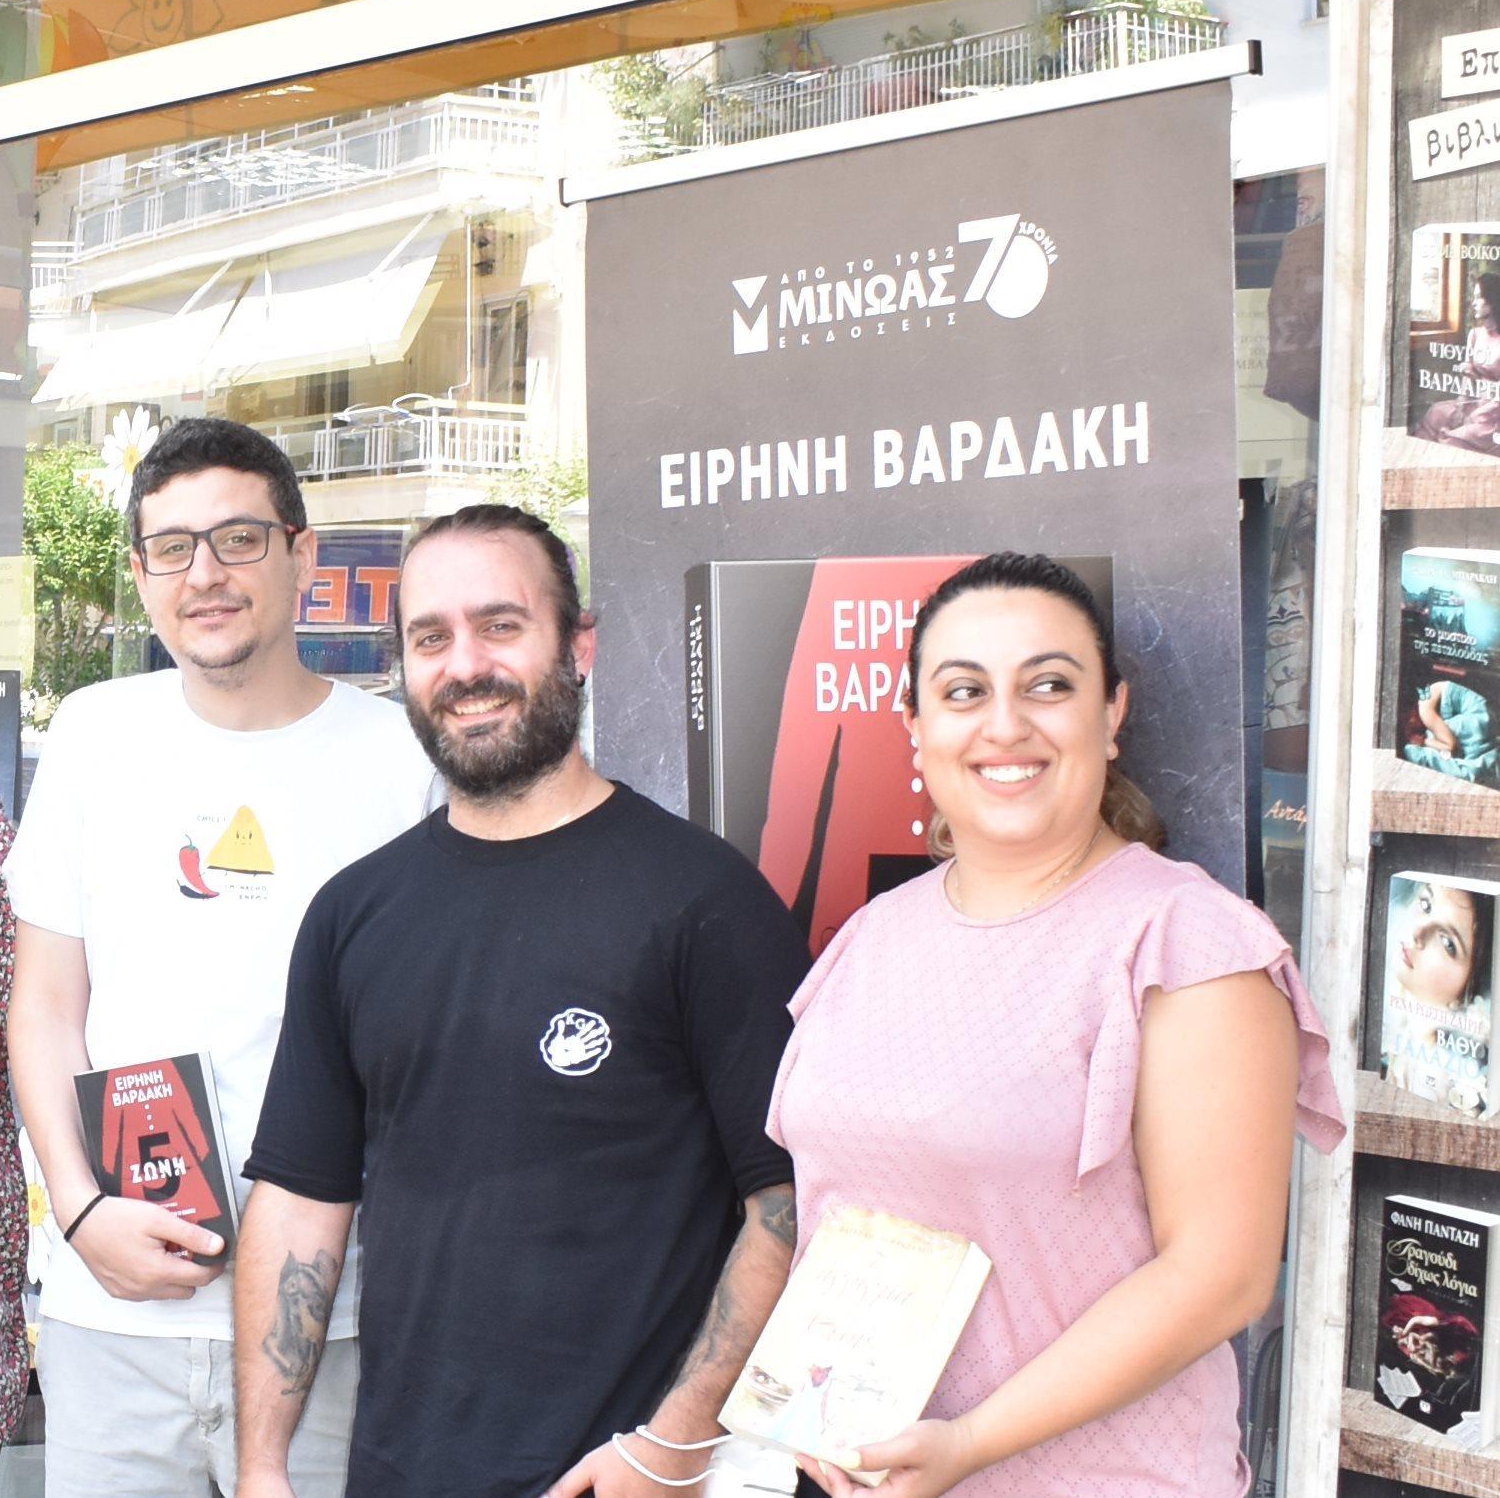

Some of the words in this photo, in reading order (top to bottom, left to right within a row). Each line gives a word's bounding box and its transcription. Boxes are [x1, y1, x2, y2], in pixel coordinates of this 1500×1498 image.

[1018, 220, 1059, 267] ΧΡΟΝΙΑ
[780, 265, 826, 285] ΑΠΟ
[846, 258, 874, 274] ΤΟ
[895, 245, 955, 266] 1952
[778, 263, 956, 329] ΜΙΝΩΑΣ
[778, 312, 956, 350] ΕΚΔΟΣΕΙΣ
[659, 434, 847, 509] ΕΙΡΗΝΗ
[872, 401, 1150, 489] ΒΑΡΔΑΚΗ
[1436, 1029, 1481, 1058] ΒΑΘΥ
[111, 1083, 173, 1107] ΒΑΡΔΑΚΗ
[114, 1069, 165, 1092] ΕΙΡΗΝΗ
[129, 1155, 187, 1184] ΖΩΝΗ
[1390, 1211, 1422, 1232] ΦΑΝΗ
[1424, 1219, 1480, 1248] ΠΑΝΤΑΖΗ
[1386, 1238, 1458, 1276] Τραγούδι
[1407, 1260, 1441, 1287] δίχως
[1442, 1270, 1478, 1298] λόγια
